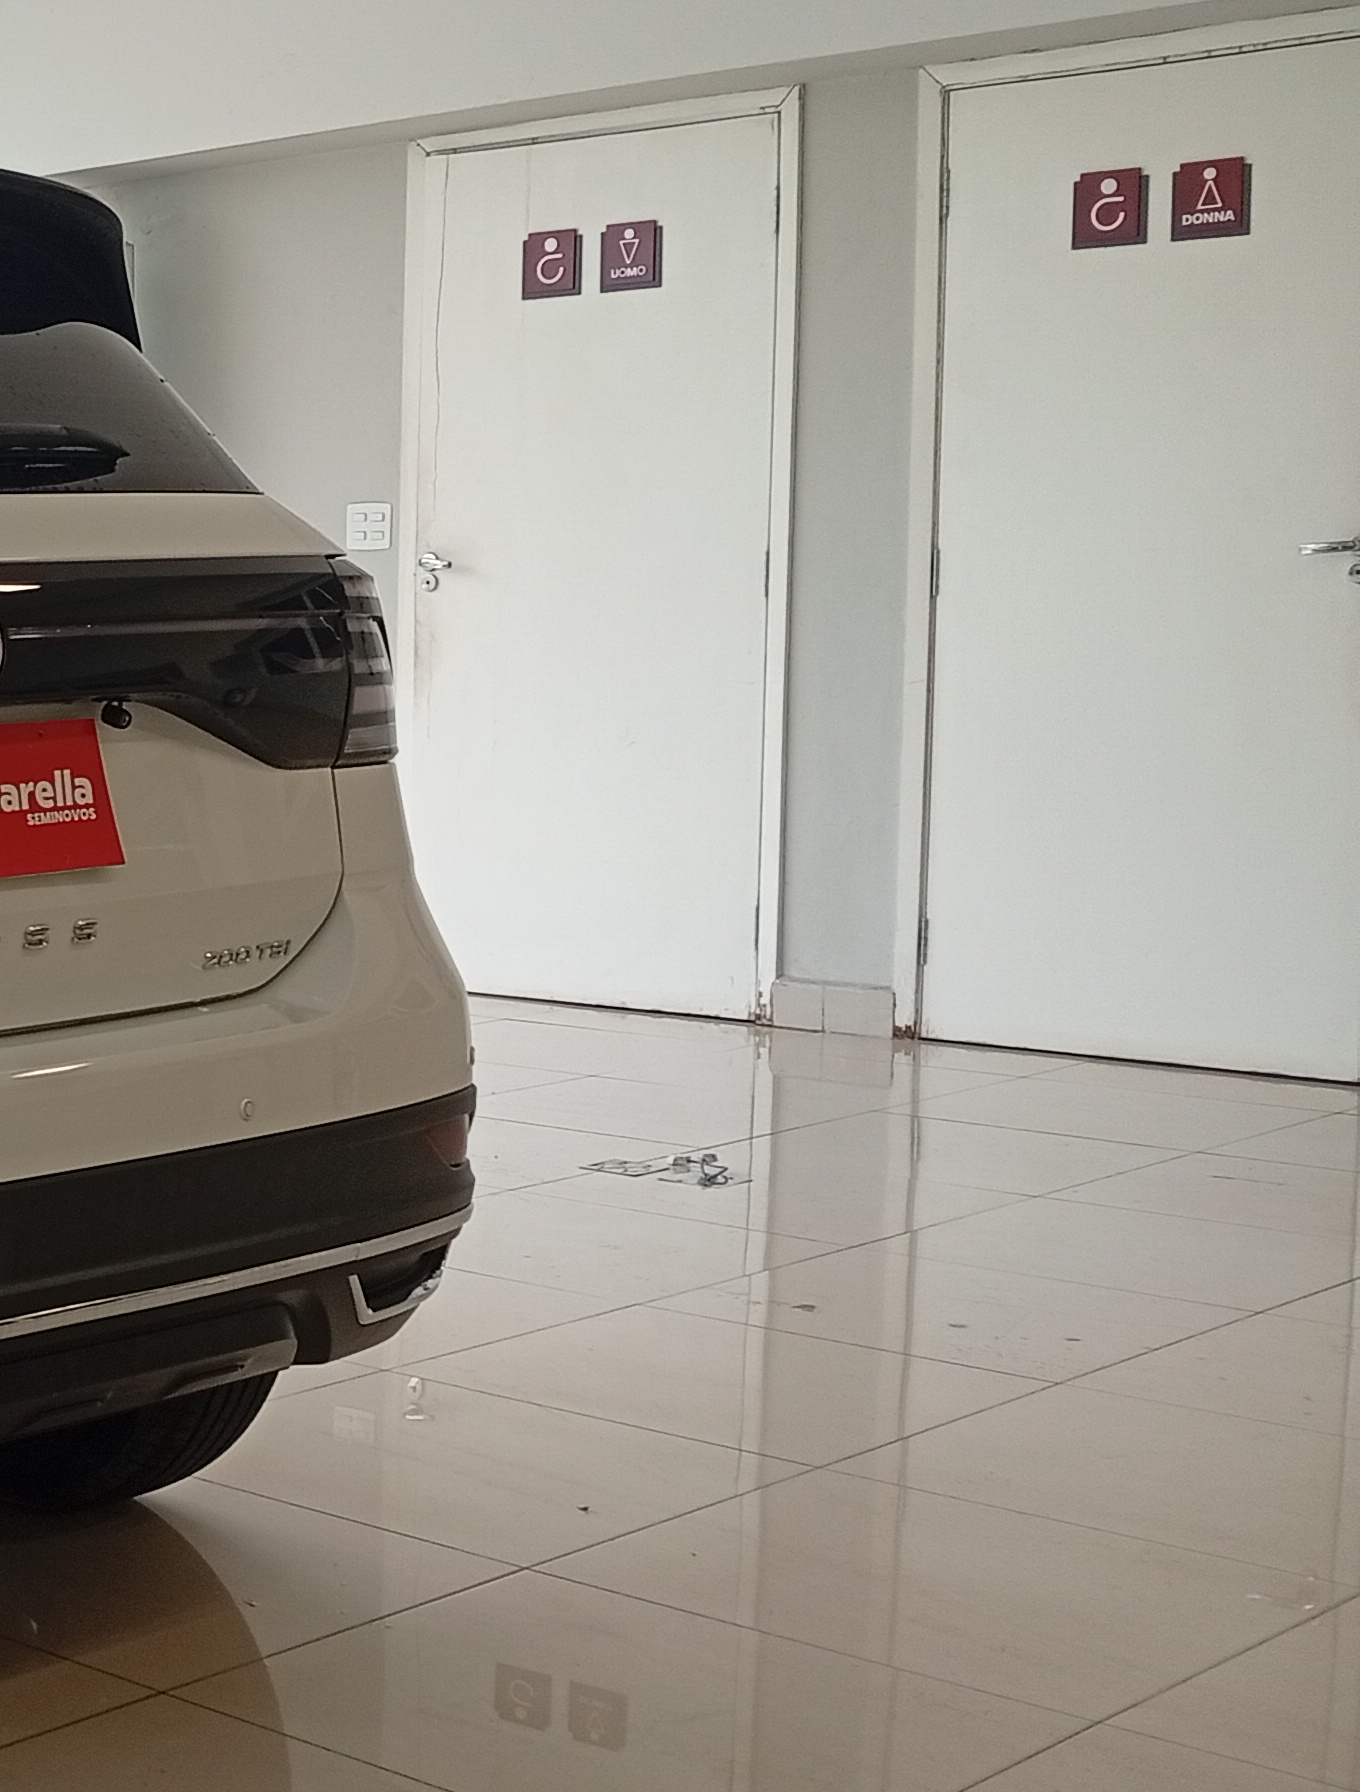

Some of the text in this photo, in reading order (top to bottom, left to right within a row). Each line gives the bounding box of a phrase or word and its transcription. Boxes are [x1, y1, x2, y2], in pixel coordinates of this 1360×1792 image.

[1181, 209, 1236, 226] DONNA
[609, 265, 647, 279] UOMO
[26, 807, 98, 826] SEMINOVOS
[202, 945, 251, 970] 200
